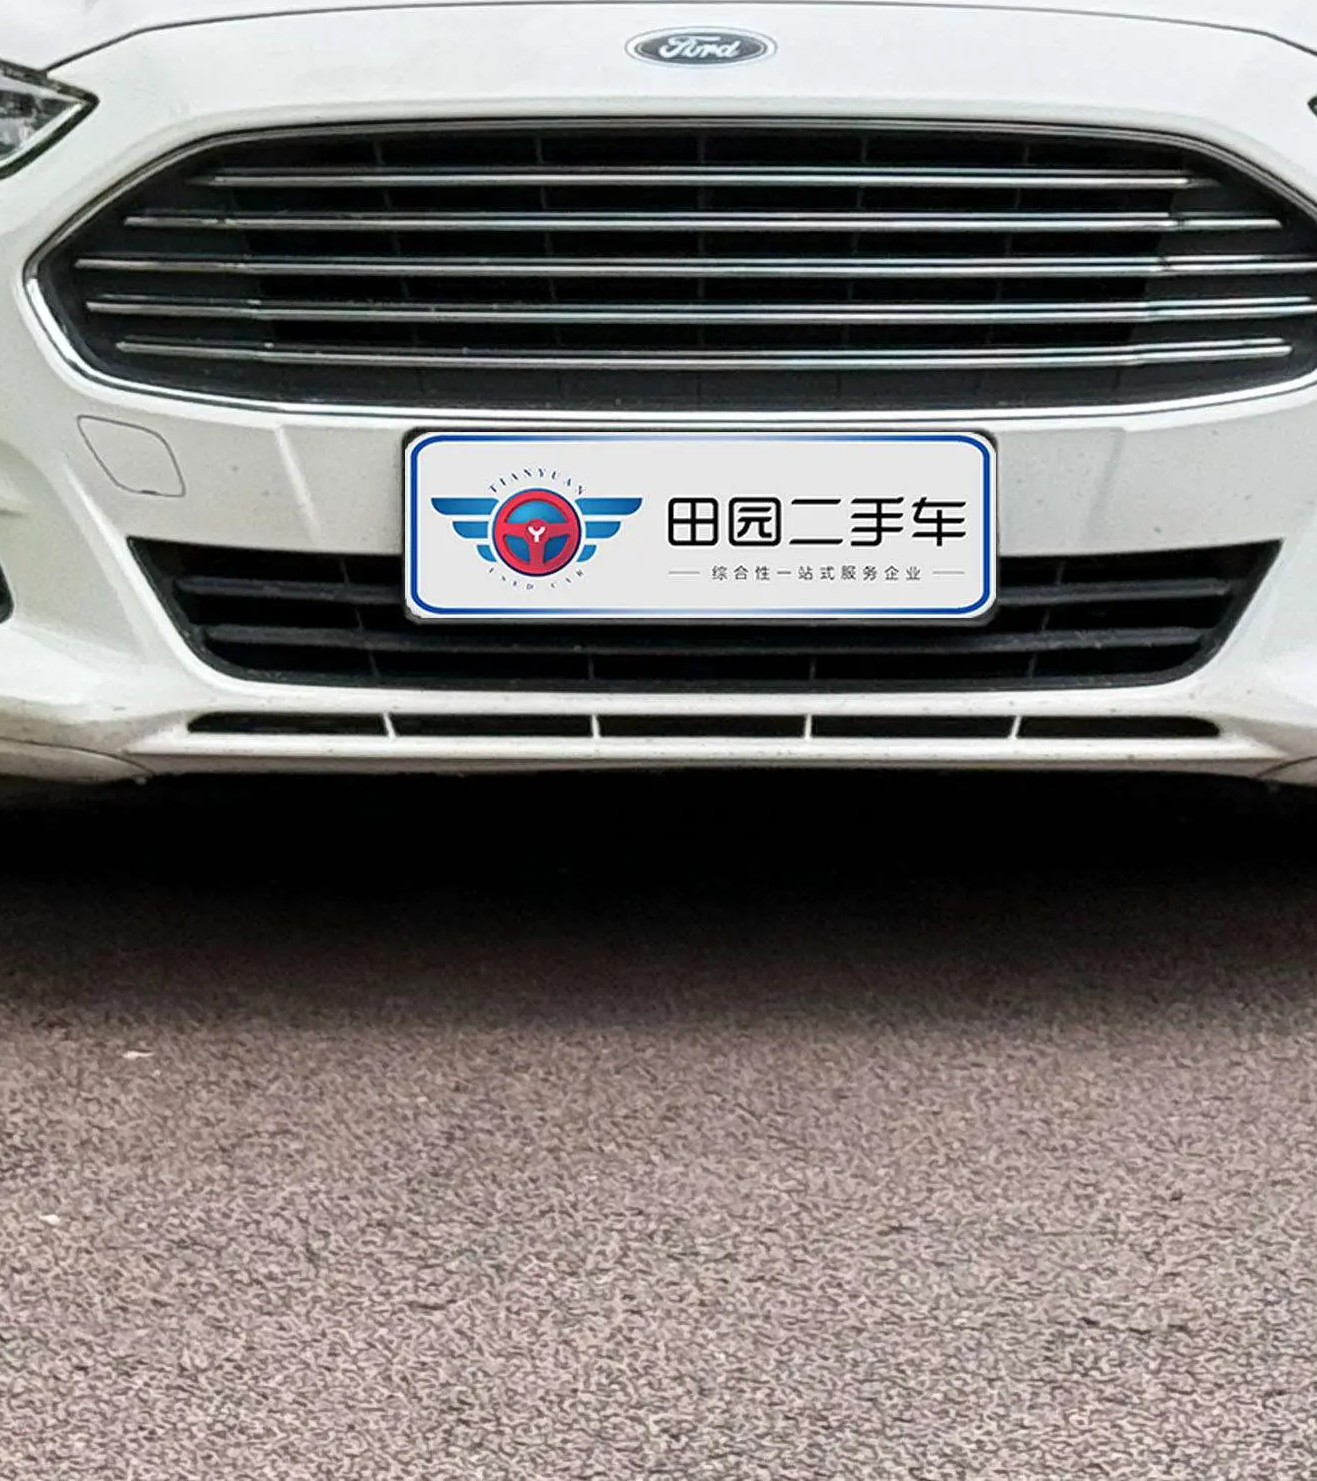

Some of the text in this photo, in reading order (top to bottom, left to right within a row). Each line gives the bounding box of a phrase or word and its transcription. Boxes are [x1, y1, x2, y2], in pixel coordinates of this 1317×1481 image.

[658, 34, 741, 59] Ford
[666, 495, 968, 548] 田园二手车
[710, 564, 922, 582] 综合性一站式服务企业
